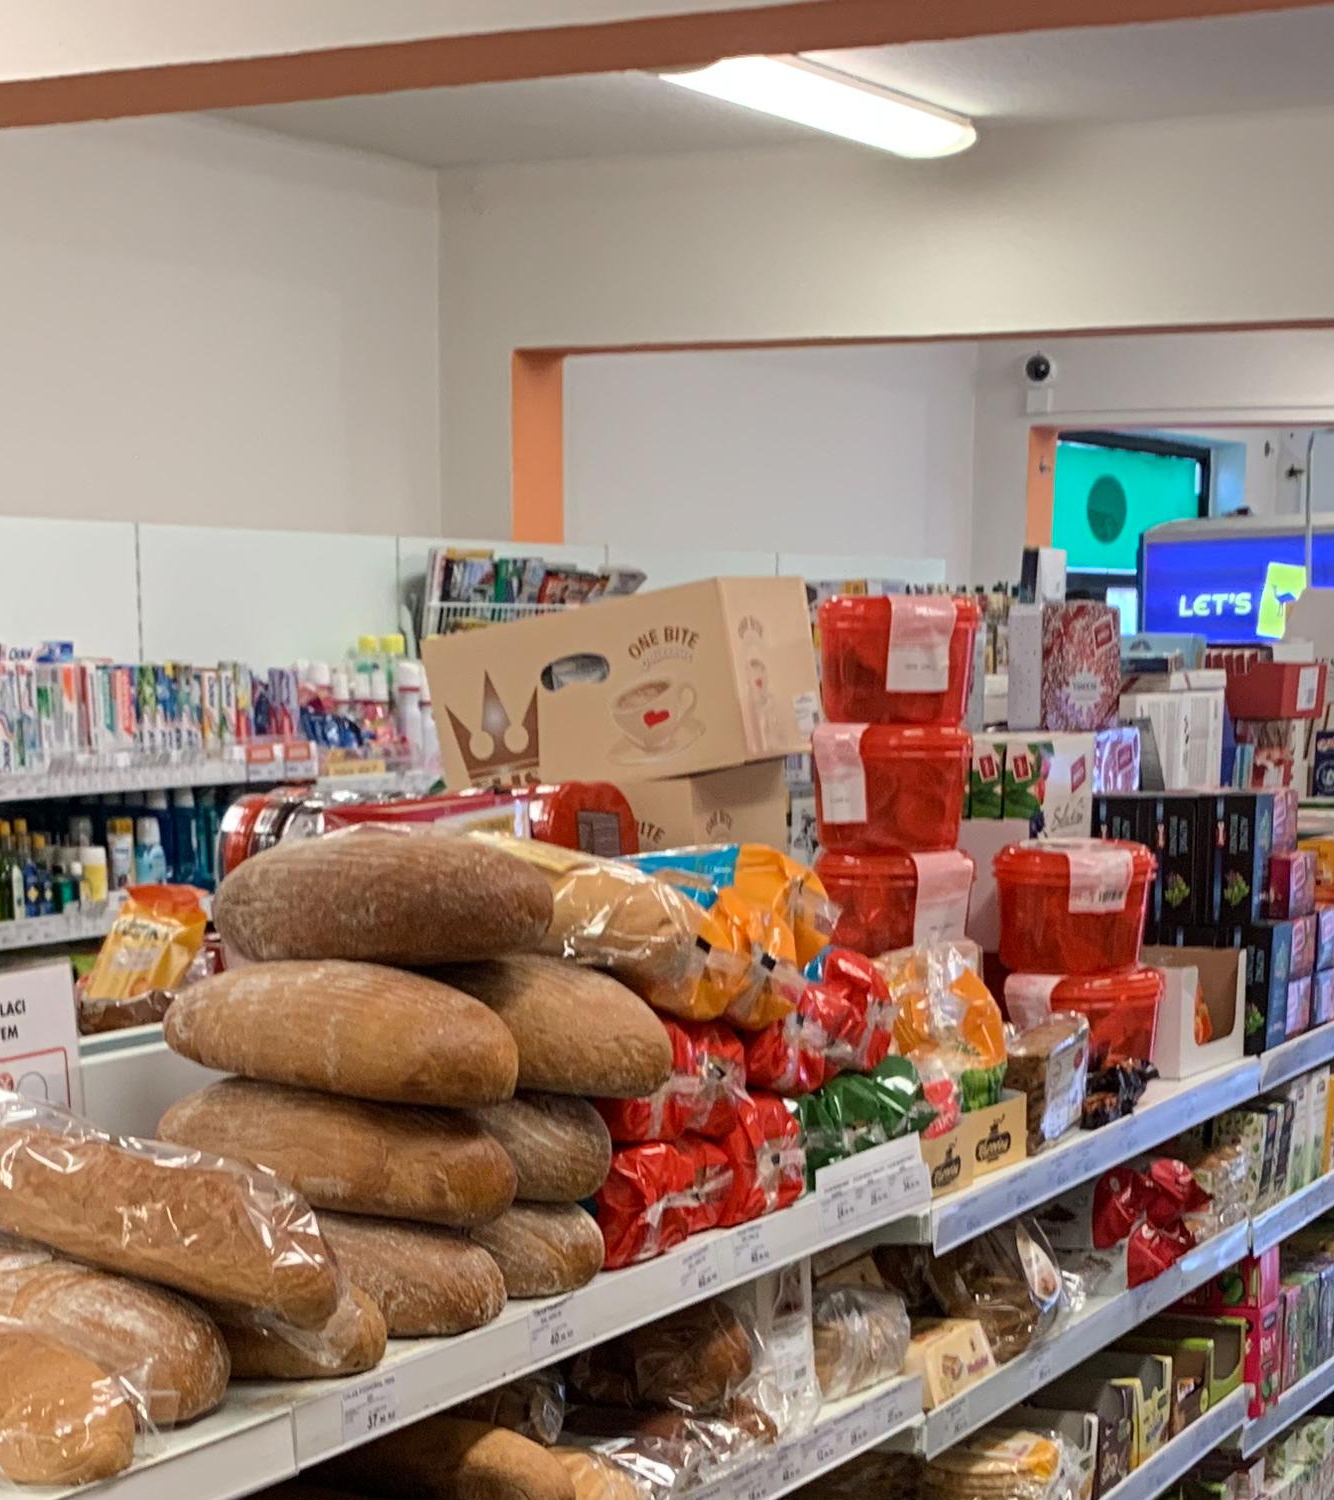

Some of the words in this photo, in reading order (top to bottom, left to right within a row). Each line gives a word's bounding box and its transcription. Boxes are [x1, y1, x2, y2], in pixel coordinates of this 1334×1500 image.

[1179, 592, 1251, 617] LET'S
[629, 629, 658, 660] ONE
[664, 625, 700, 650] BITE
[638, 822, 667, 845] ITE
